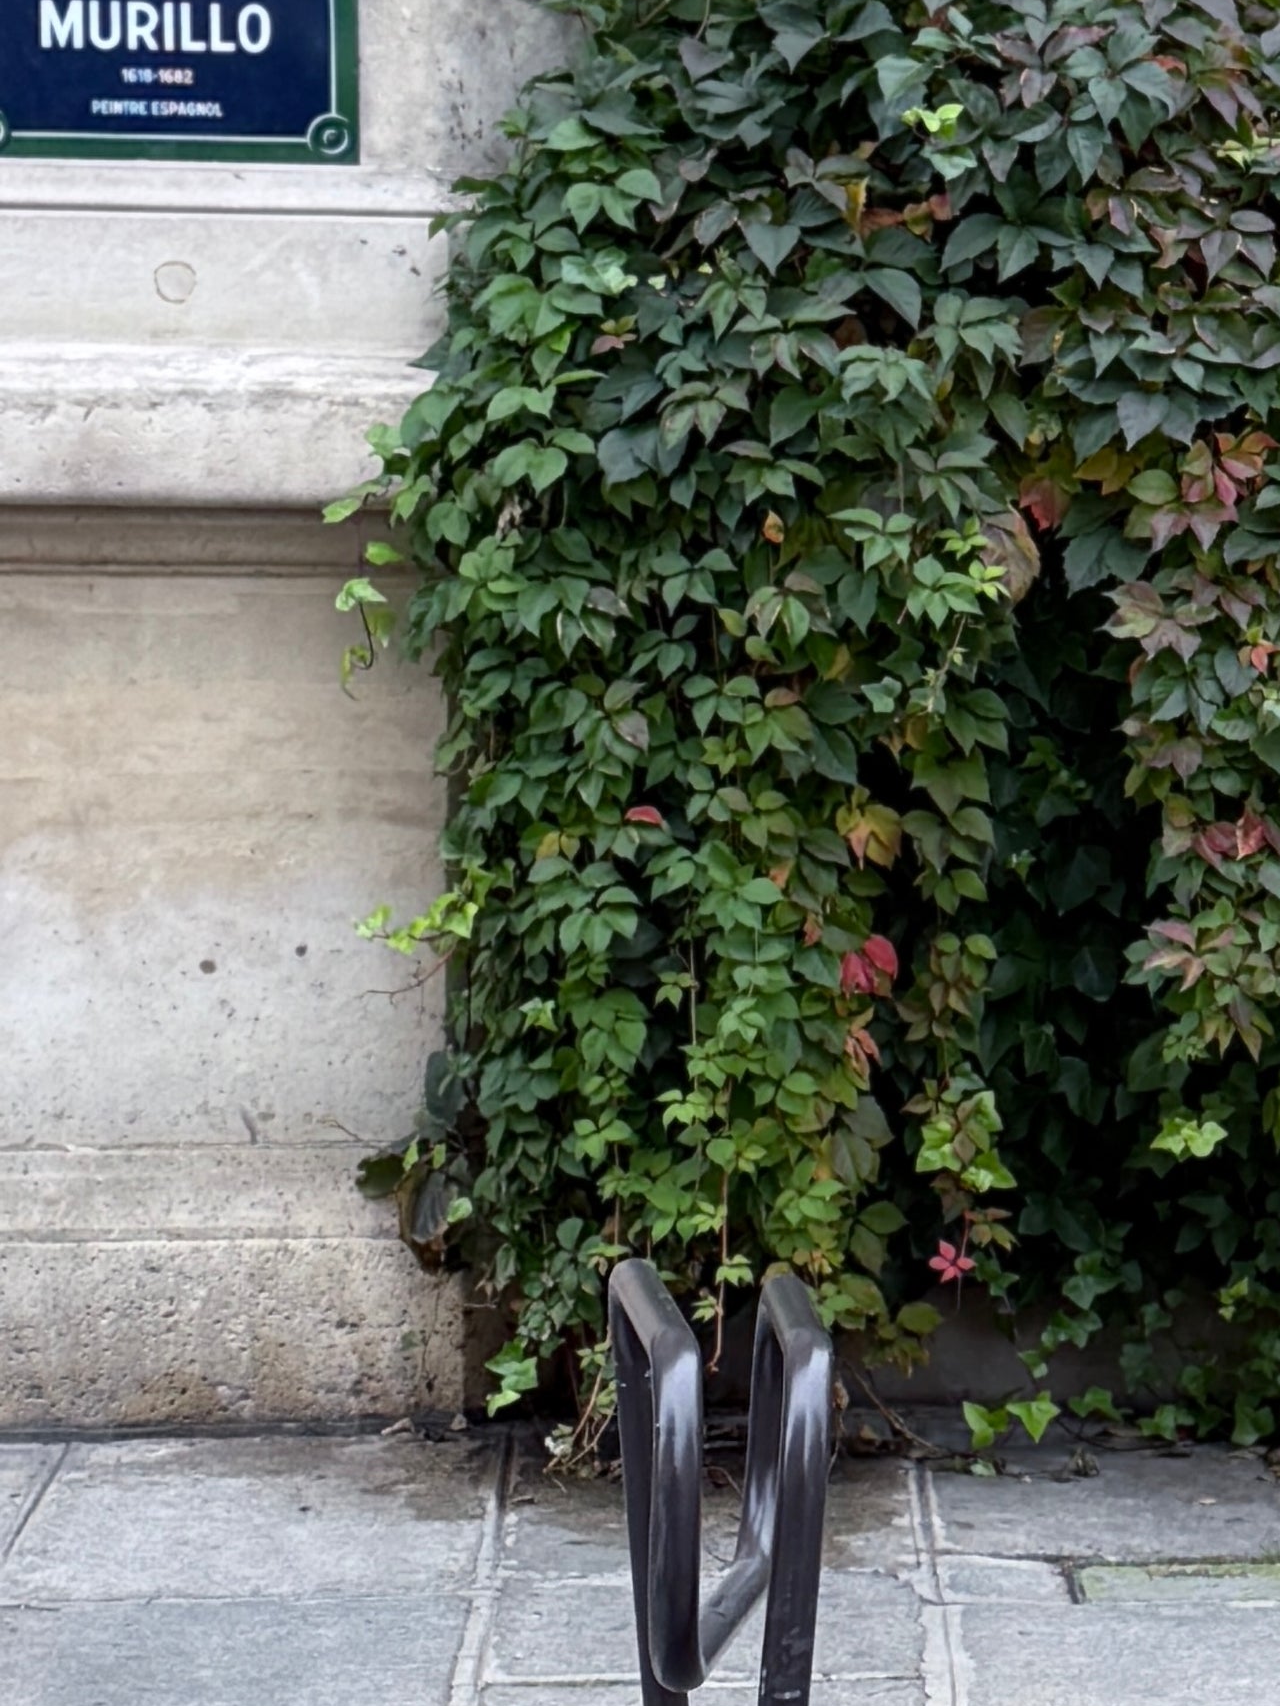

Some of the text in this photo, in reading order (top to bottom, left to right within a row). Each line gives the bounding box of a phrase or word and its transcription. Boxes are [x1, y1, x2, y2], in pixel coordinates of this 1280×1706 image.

[120, 67, 195, 86] 1618-1682
[91, 99, 223, 118] PEINTRE ESPAGNOL
